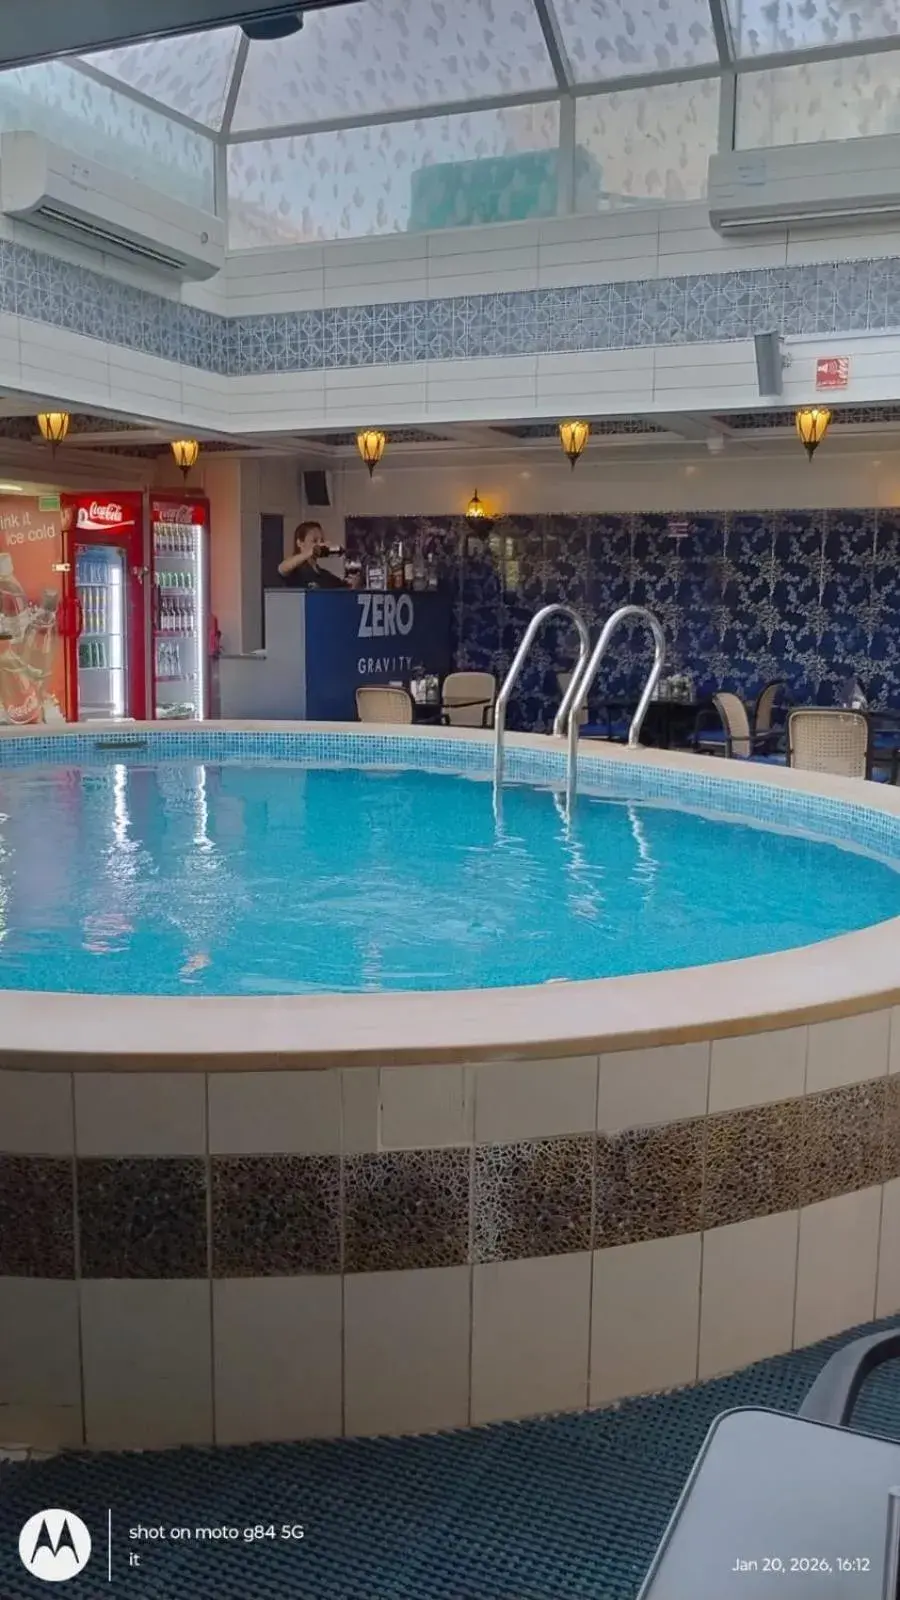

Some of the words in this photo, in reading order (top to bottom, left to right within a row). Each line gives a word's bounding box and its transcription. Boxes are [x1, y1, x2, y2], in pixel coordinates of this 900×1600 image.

[22, 512, 32, 526] it
[7, 531, 25, 546] ice
[28, 523, 55, 541] cold
[357, 593, 414, 638] ZERO
[358, 656, 413, 674] GRAVITY
